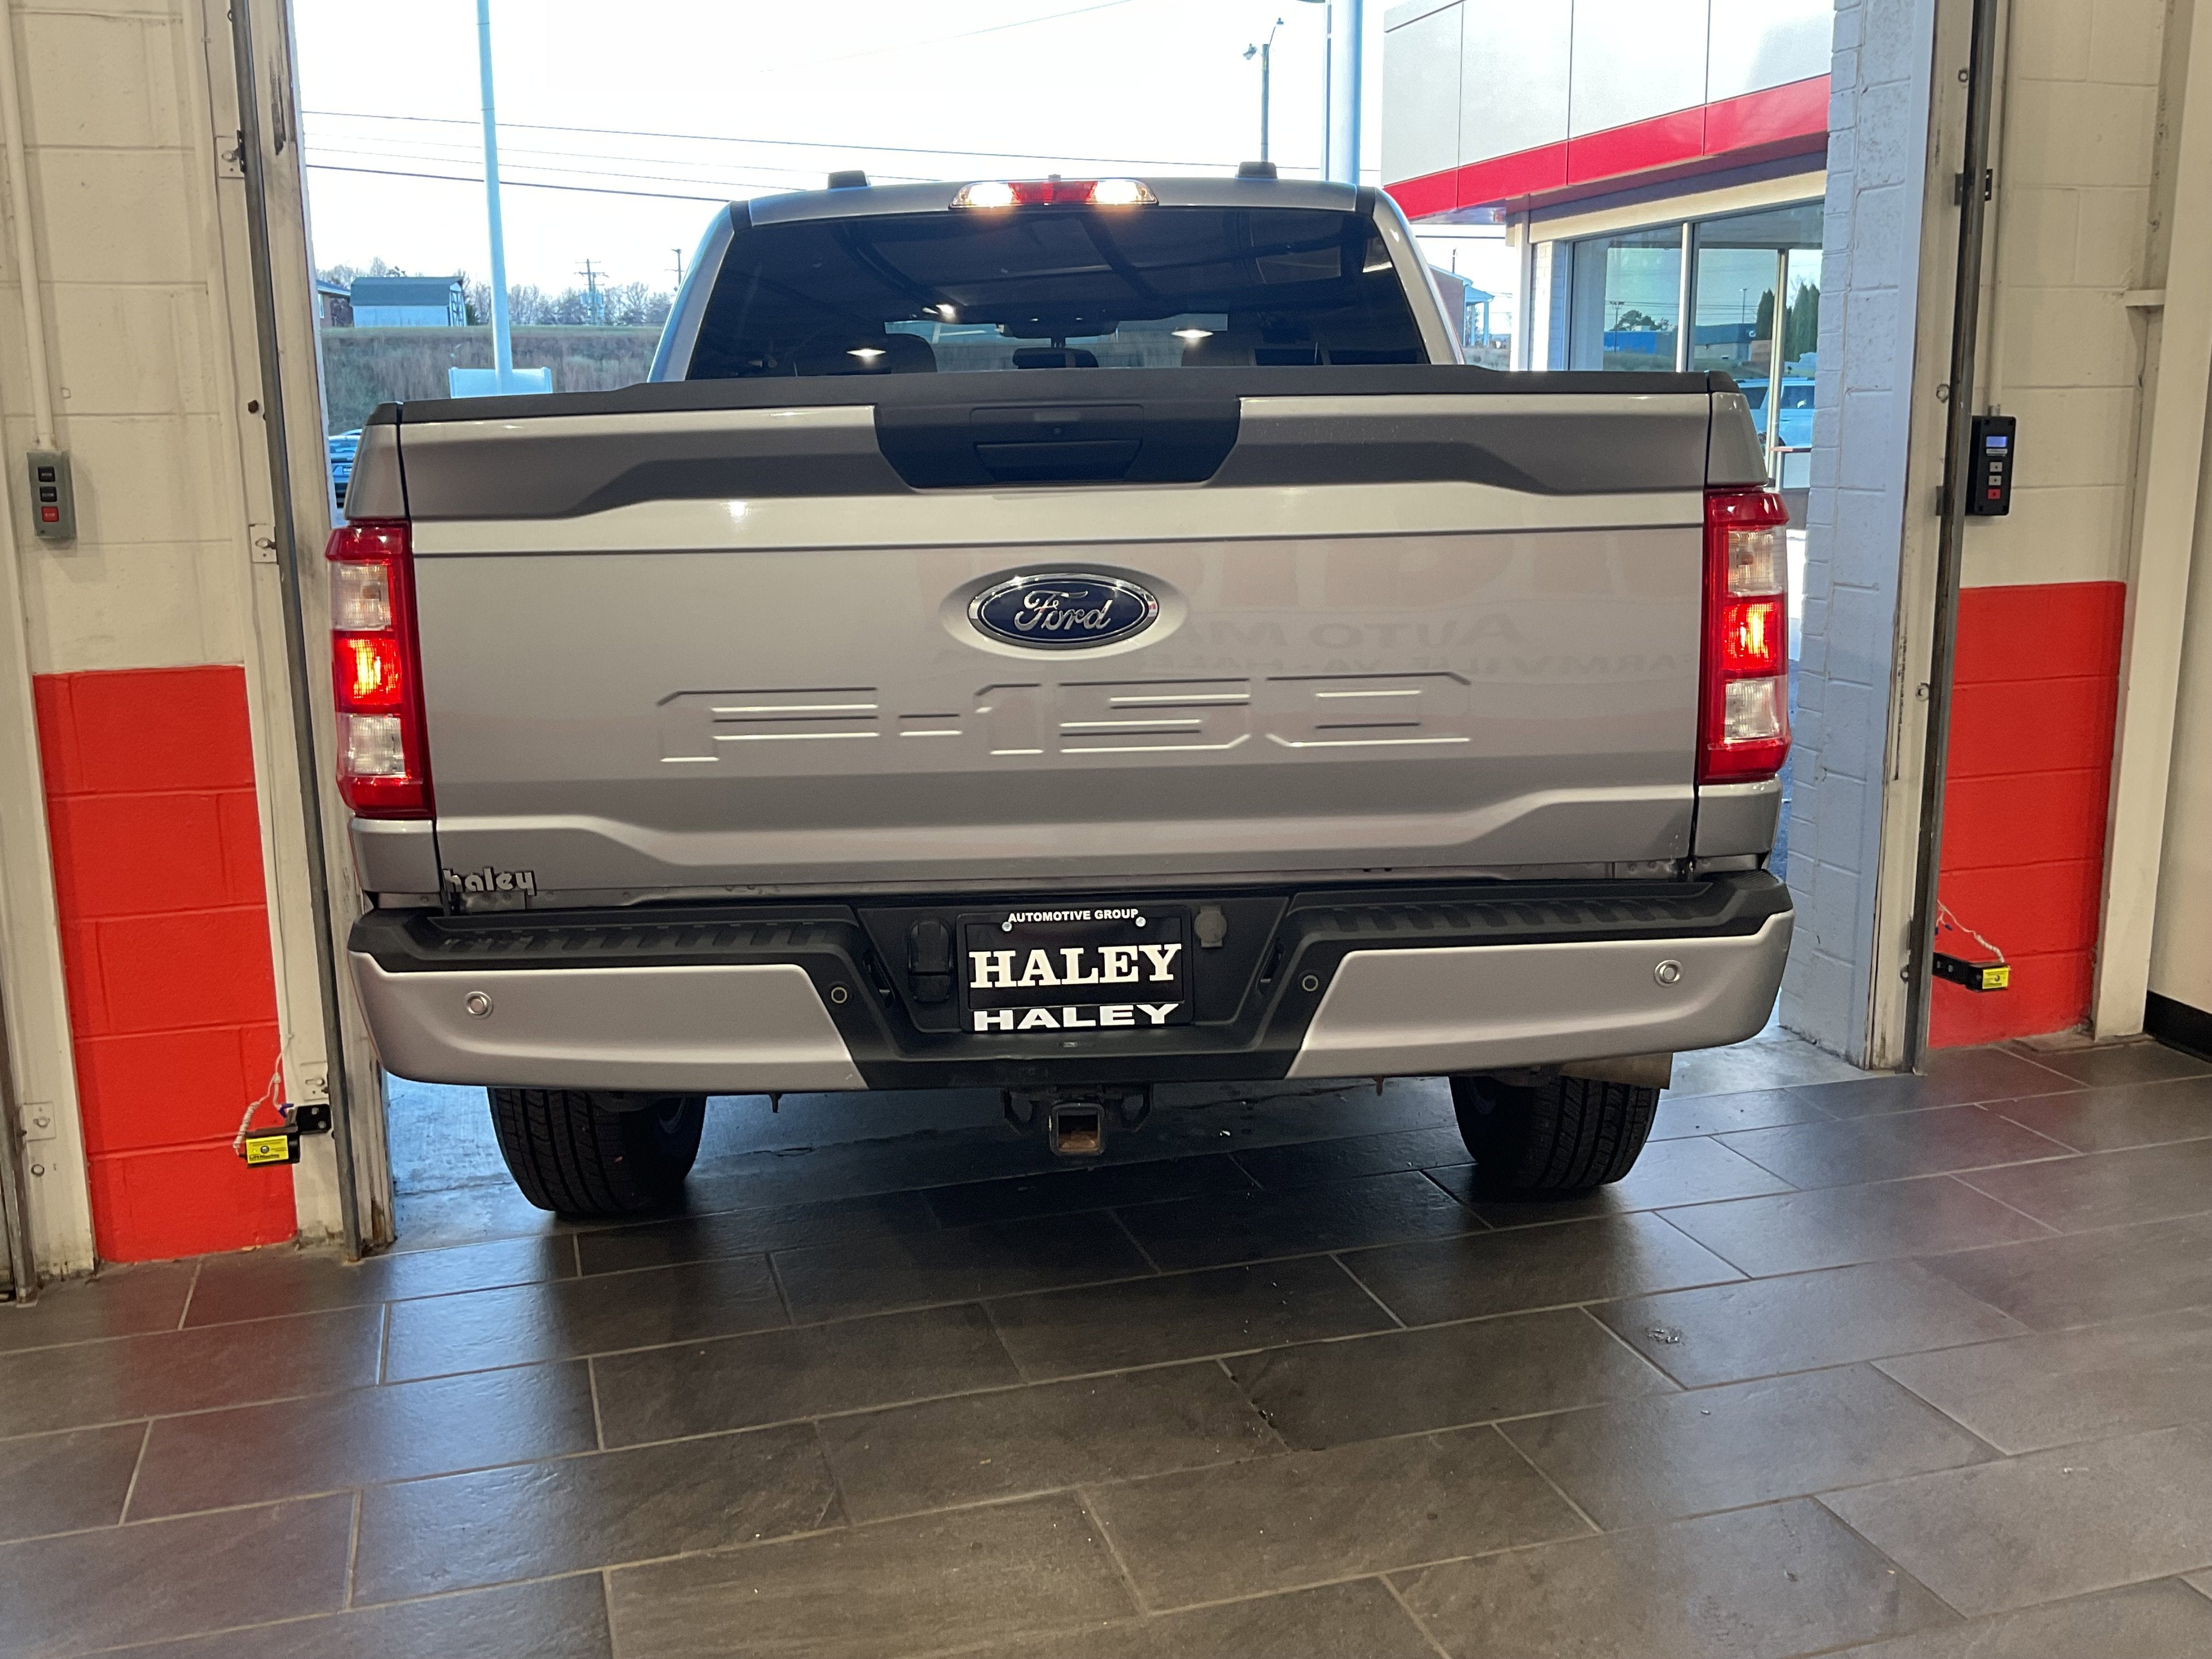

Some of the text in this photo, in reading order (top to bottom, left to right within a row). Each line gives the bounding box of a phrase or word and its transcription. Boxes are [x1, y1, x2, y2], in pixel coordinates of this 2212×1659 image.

[1014, 590, 1111, 631] Ford
[657, 673, 1471, 762] F-150
[442, 867, 535, 896] haley
[1008, 909, 1139, 923] AUTOMOTIVE GROUP
[968, 943, 1182, 988] HALEY
[973, 1003, 1179, 1031] HALEY
